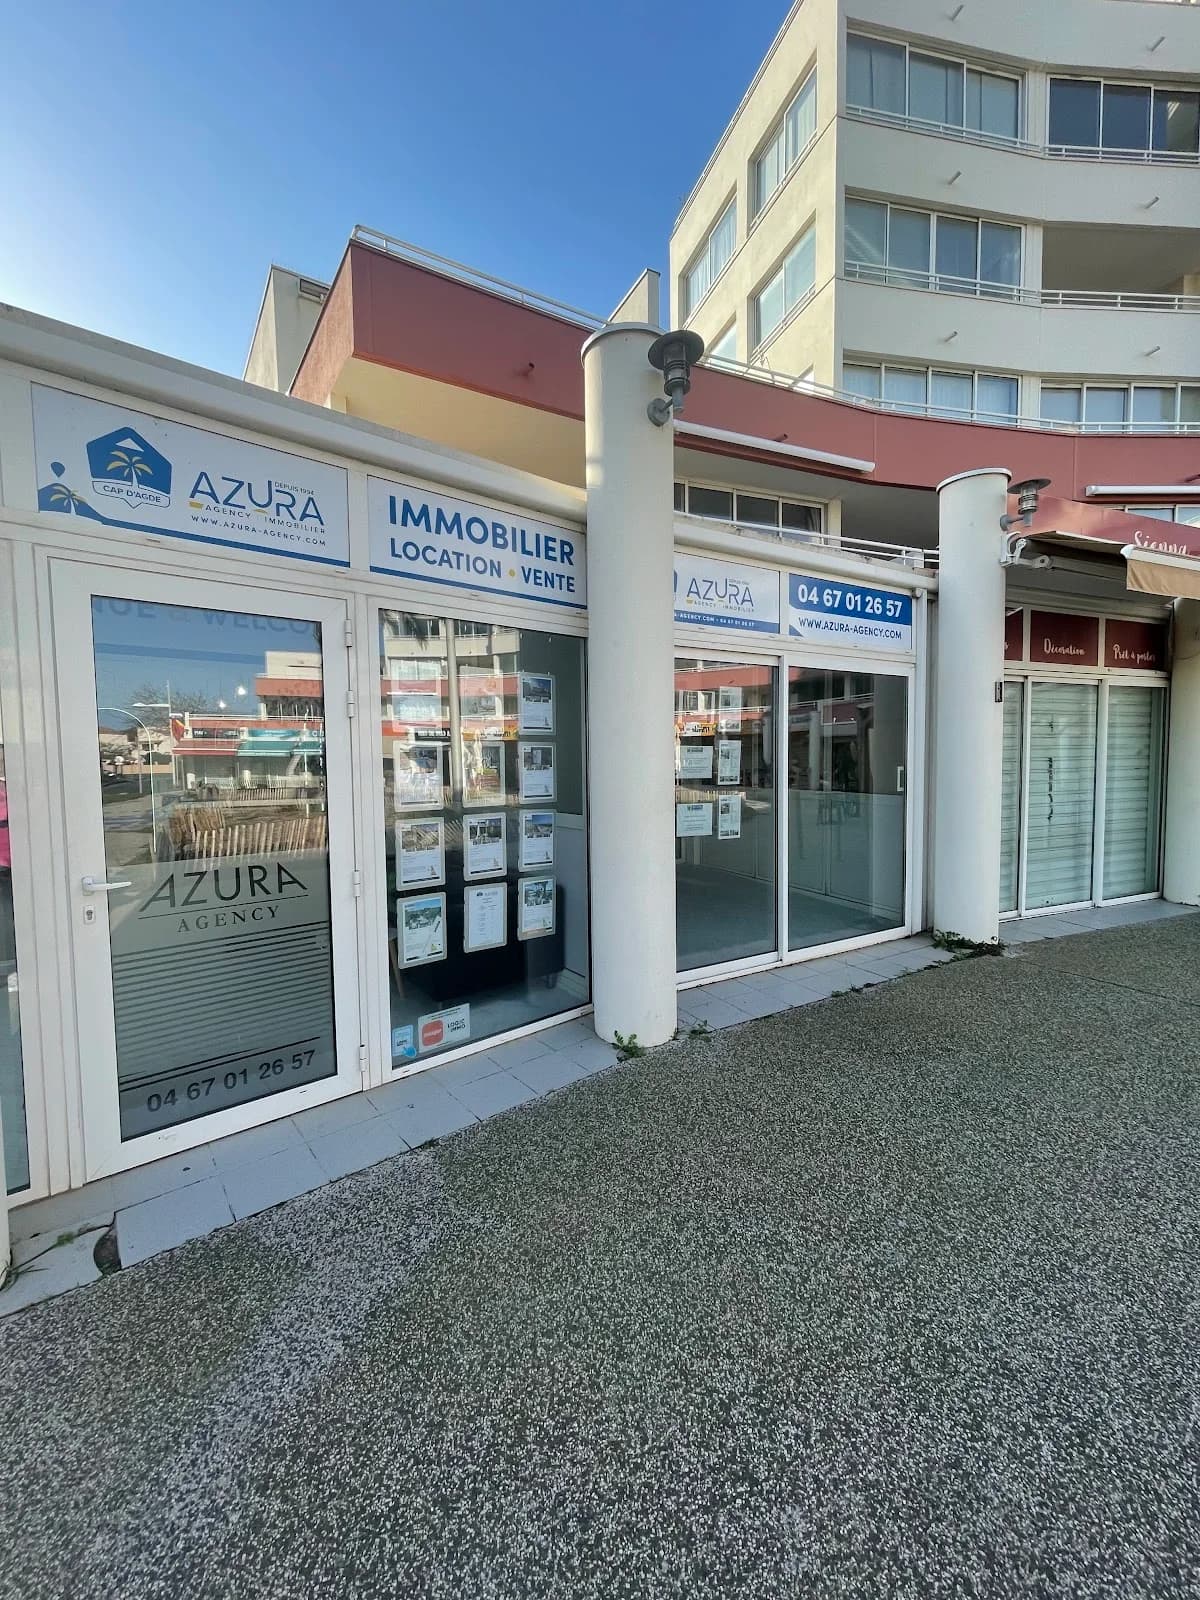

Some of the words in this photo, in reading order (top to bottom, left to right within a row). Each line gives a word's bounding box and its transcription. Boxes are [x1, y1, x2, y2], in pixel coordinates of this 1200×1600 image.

[103, 485, 124, 495] CAP
[126, 489, 161, 503] D'AGDE
[189, 471, 325, 526] AZURA
[274, 481, 299, 493] DEPUIS
[191, 515, 326, 547] WWW.AZURA-AGENCY.COM
[205, 504, 251, 518] AGENCY
[264, 516, 326, 534] IMMOBILIER
[389, 495, 575, 566] IMMOBILIER
[390, 537, 501, 578] LOCATION
[521, 565, 576, 593] VENTE
[686, 577, 754, 608] AZURA
[797, 584, 819, 605] 04
[822, 588, 842, 608] 67
[845, 592, 862, 613] 01
[865, 596, 883, 615] 26
[886, 599, 903, 618] 57
[798, 616, 903, 641] WWW.AZURA-AGENCY.COM
[139, 862, 308, 912] AZURA
[178, 905, 279, 932] AGENCY
[147, 1088, 178, 1112] 04
[186, 1077, 215, 1101] 67
[223, 1068, 248, 1090] 01
[259, 1058, 284, 1080] 26
[291, 1049, 316, 1070] 57
